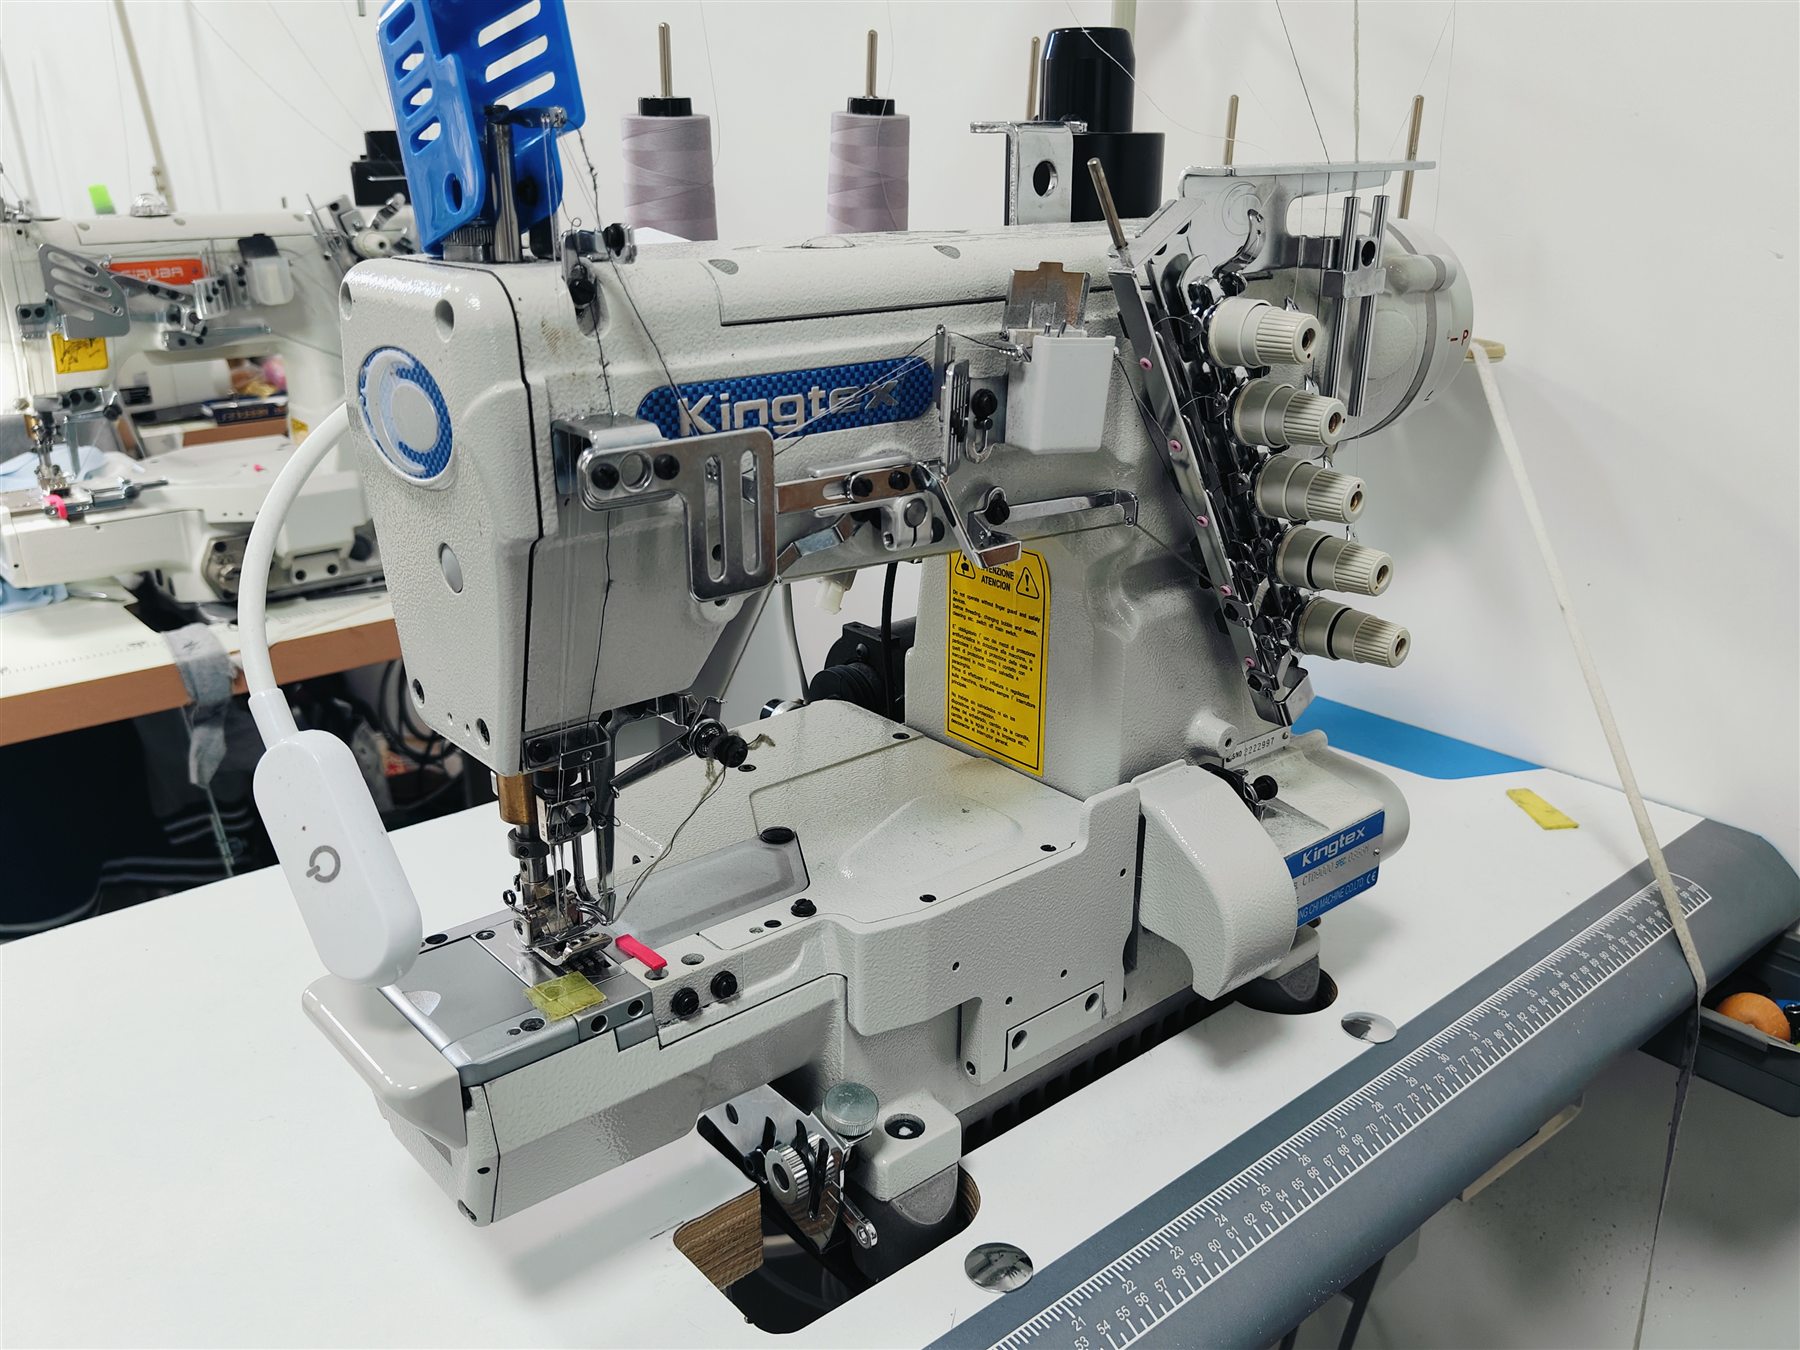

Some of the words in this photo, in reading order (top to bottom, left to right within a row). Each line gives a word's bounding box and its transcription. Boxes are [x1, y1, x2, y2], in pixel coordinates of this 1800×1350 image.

[680, 380, 900, 436] Kingtex
[981, 575, 1010, 592] ATENCION
[1244, 737, 1274, 756] 2222997
[1302, 826, 1365, 867] Kingtex
[1074, 1336, 1090, 1350] 53
[1097, 1320, 1111, 1335] 54
[1116, 1305, 1131, 1321] 55
[1135, 1292, 1149, 1306] 56
[1154, 1277, 1168, 1292] 57
[1172, 1265, 1186, 1279] 58
[1190, 1252, 1204, 1266] 59
[1208, 1239, 1221, 1253] 60
[1226, 1225, 1240, 1239] 61
[1243, 1212, 1257, 1227] 62
[1260, 1201, 1273, 1214] 63
[1276, 1190, 1289, 1202] 64
[1292, 1178, 1304, 1190] 65
[1307, 1167, 1320, 1179] 66
[1323, 1155, 1335, 1167] 67
[1338, 1144, 1350, 1156] 68
[1352, 1134, 1364, 1145] 69
[1366, 1123, 1378, 1135] 70
[1379, 1115, 1392, 1125] 71
[1394, 1103, 1406, 1114] 72
[1407, 1093, 1420, 1104] 73
[1420, 1084, 1433, 1094] 74
[1434, 1074, 1445, 1084] 75
[1445, 1065, 1457, 1075] 76
[1458, 1055, 1469, 1065] 77
[1470, 1047, 1481, 1056] 78
[1481, 1038, 1493, 1048] 79
[1493, 1029, 1505, 1039] 80
[1505, 1021, 1516, 1030] 81
[1517, 1012, 1528, 1021] 82
[1528, 1004, 1538, 1013] 83
[1538, 997, 1549, 1006] 84
[1549, 988, 1559, 997] 85
[1559, 981, 1569, 989] 86
[1570, 972, 1579, 981] 87
[1579, 966, 1589, 974] 88
[1589, 959, 1599, 967] 89
[1599, 951, 1609, 959] 90
[1608, 943, 1618, 952] 91
[1618, 937, 1628, 945] 92
[1628, 930, 1637, 938] 93
[1646, 916, 1655, 924] 95
[1071, 1317, 1087, 1331] 21
[1122, 1280, 1137, 1295] 22
[1170, 1246, 1184, 1260] 23
[1215, 1214, 1228, 1227] 24
[1257, 1184, 1271, 1196] 25
[1298, 1154, 1311, 1167] 26
[1336, 1127, 1349, 1140] 27
[1371, 1101, 1384, 1113] 28
[1406, 1076, 1418, 1087] 29
[1438, 1054, 1449, 1064] 30
[1469, 1032, 1480, 1040] 31
[1498, 1010, 1509, 1018] 32
[1527, 989, 1538, 997] 33
